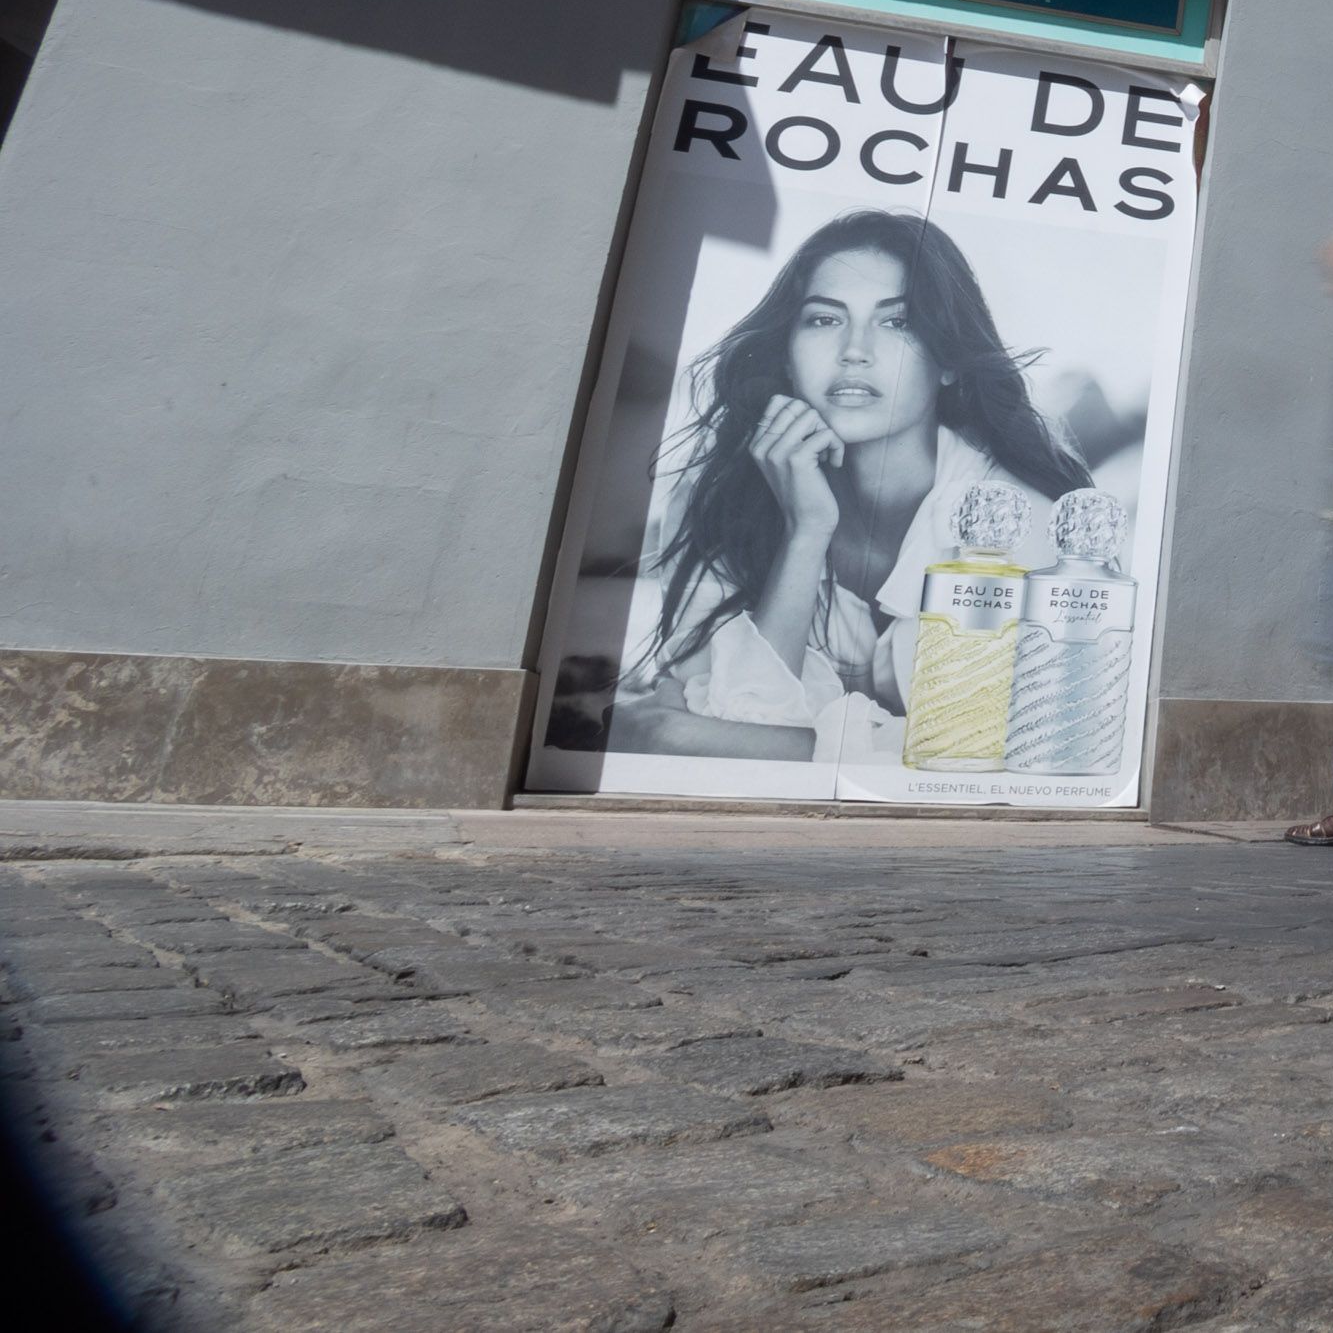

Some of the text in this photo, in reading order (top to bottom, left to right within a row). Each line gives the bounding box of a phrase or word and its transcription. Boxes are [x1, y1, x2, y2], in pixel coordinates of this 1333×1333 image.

[691, 21, 1188, 154] EAU DE
[672, 99, 1176, 221] ROCHAS
[954, 585, 1014, 598] EAU DE
[1051, 587, 1109, 599] EAU DE
[952, 598, 1012, 610] ROCHAS
[1050, 600, 1108, 611] ROCHAS
[990, 784, 1004, 795] EL
[1009, 785, 1051, 796] NUEVO
[1055, 786, 1112, 797] PERFUME
